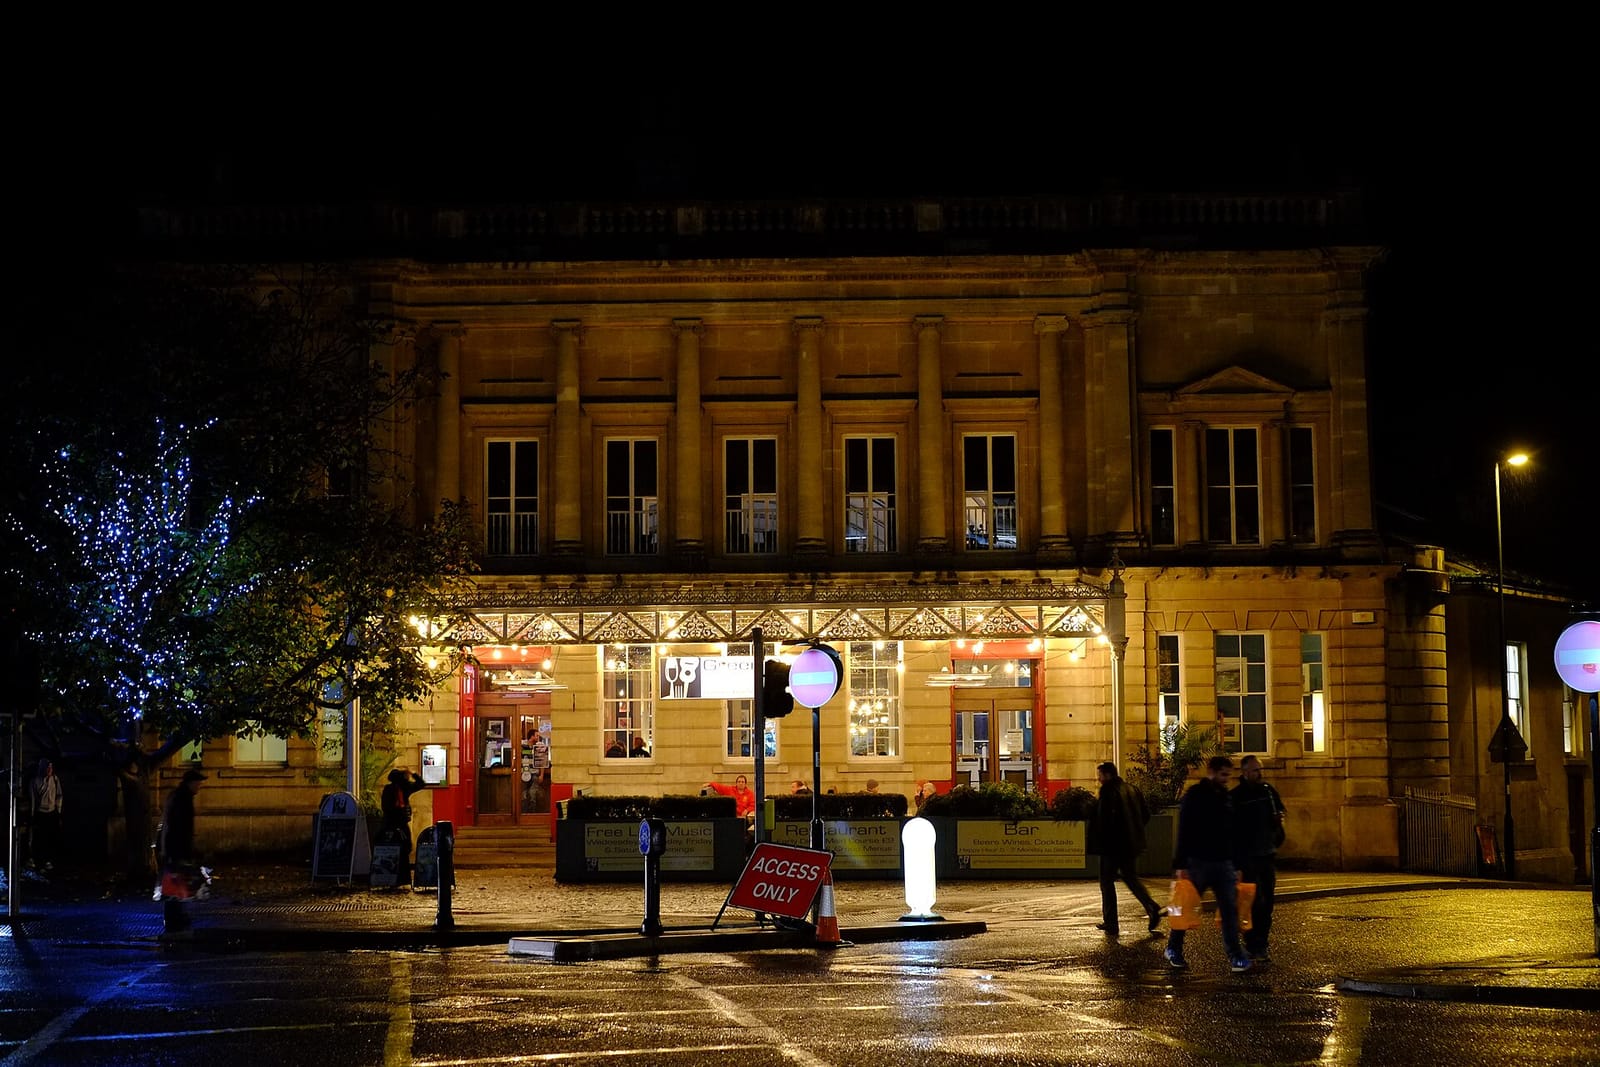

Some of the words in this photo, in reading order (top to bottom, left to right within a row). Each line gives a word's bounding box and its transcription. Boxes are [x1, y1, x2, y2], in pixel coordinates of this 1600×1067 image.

[586, 826, 623, 838] Free
[665, 825, 712, 837] Music
[785, 824, 887, 836] Reaurant
[1004, 823, 1040, 836] Bar
[751, 857, 820, 881] ACCESS
[752, 882, 800, 903] ONLY
